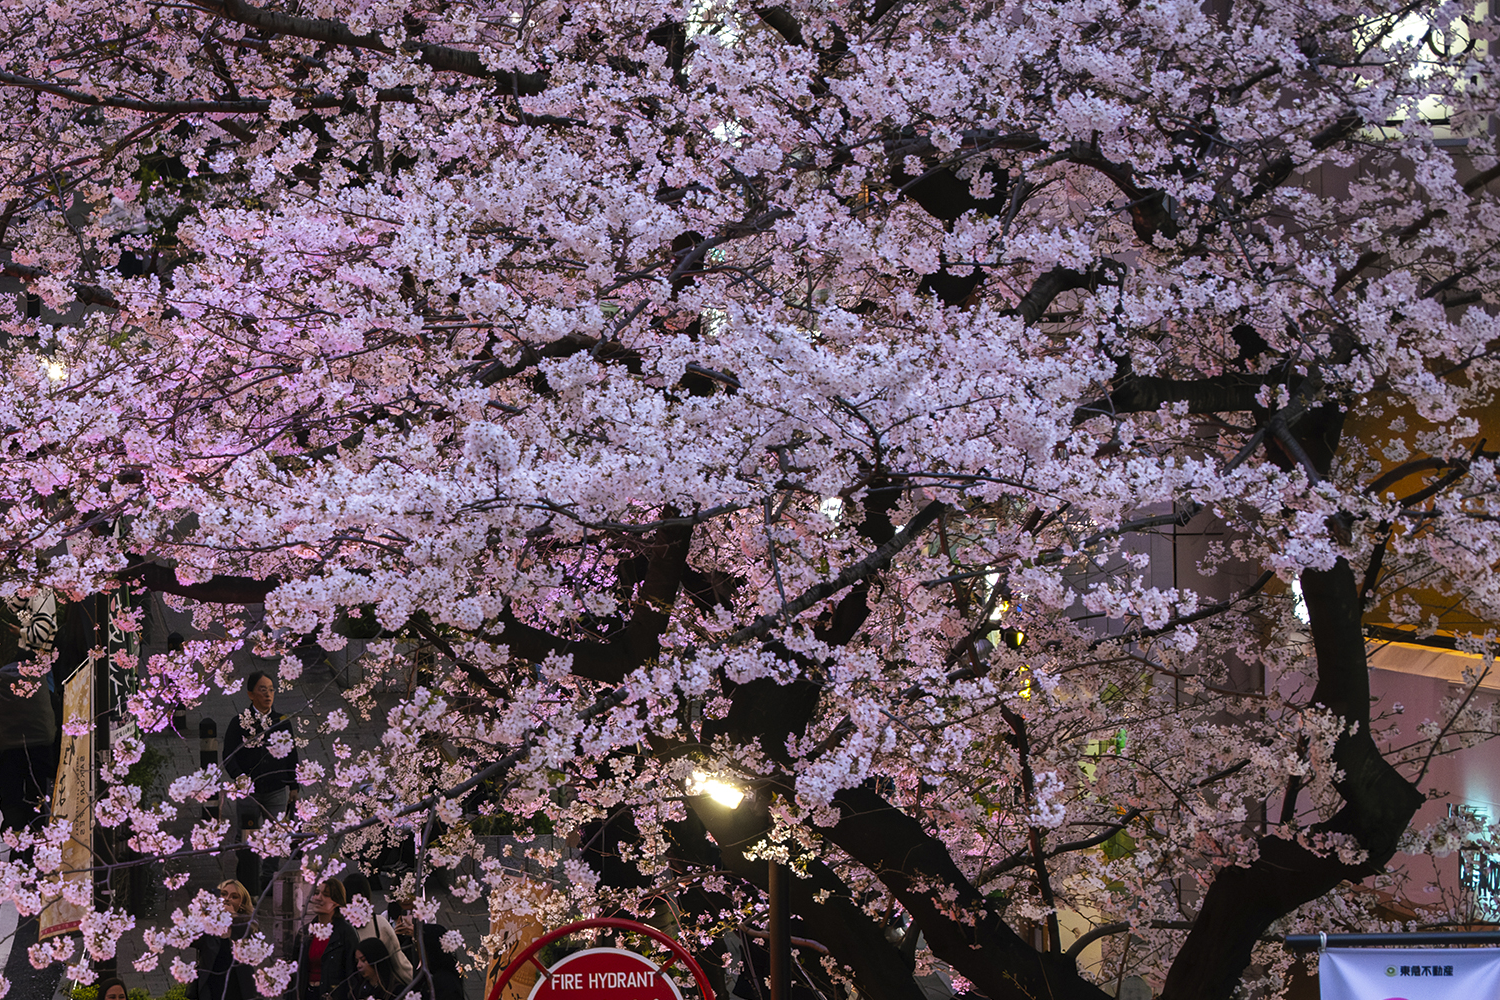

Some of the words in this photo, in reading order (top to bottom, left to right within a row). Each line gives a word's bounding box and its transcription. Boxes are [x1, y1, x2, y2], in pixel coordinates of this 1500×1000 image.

[1400, 965, 1454, 977] 東急不動産
[552, 973, 583, 990] FIRE
[588, 971, 656, 989] HYDRANT
